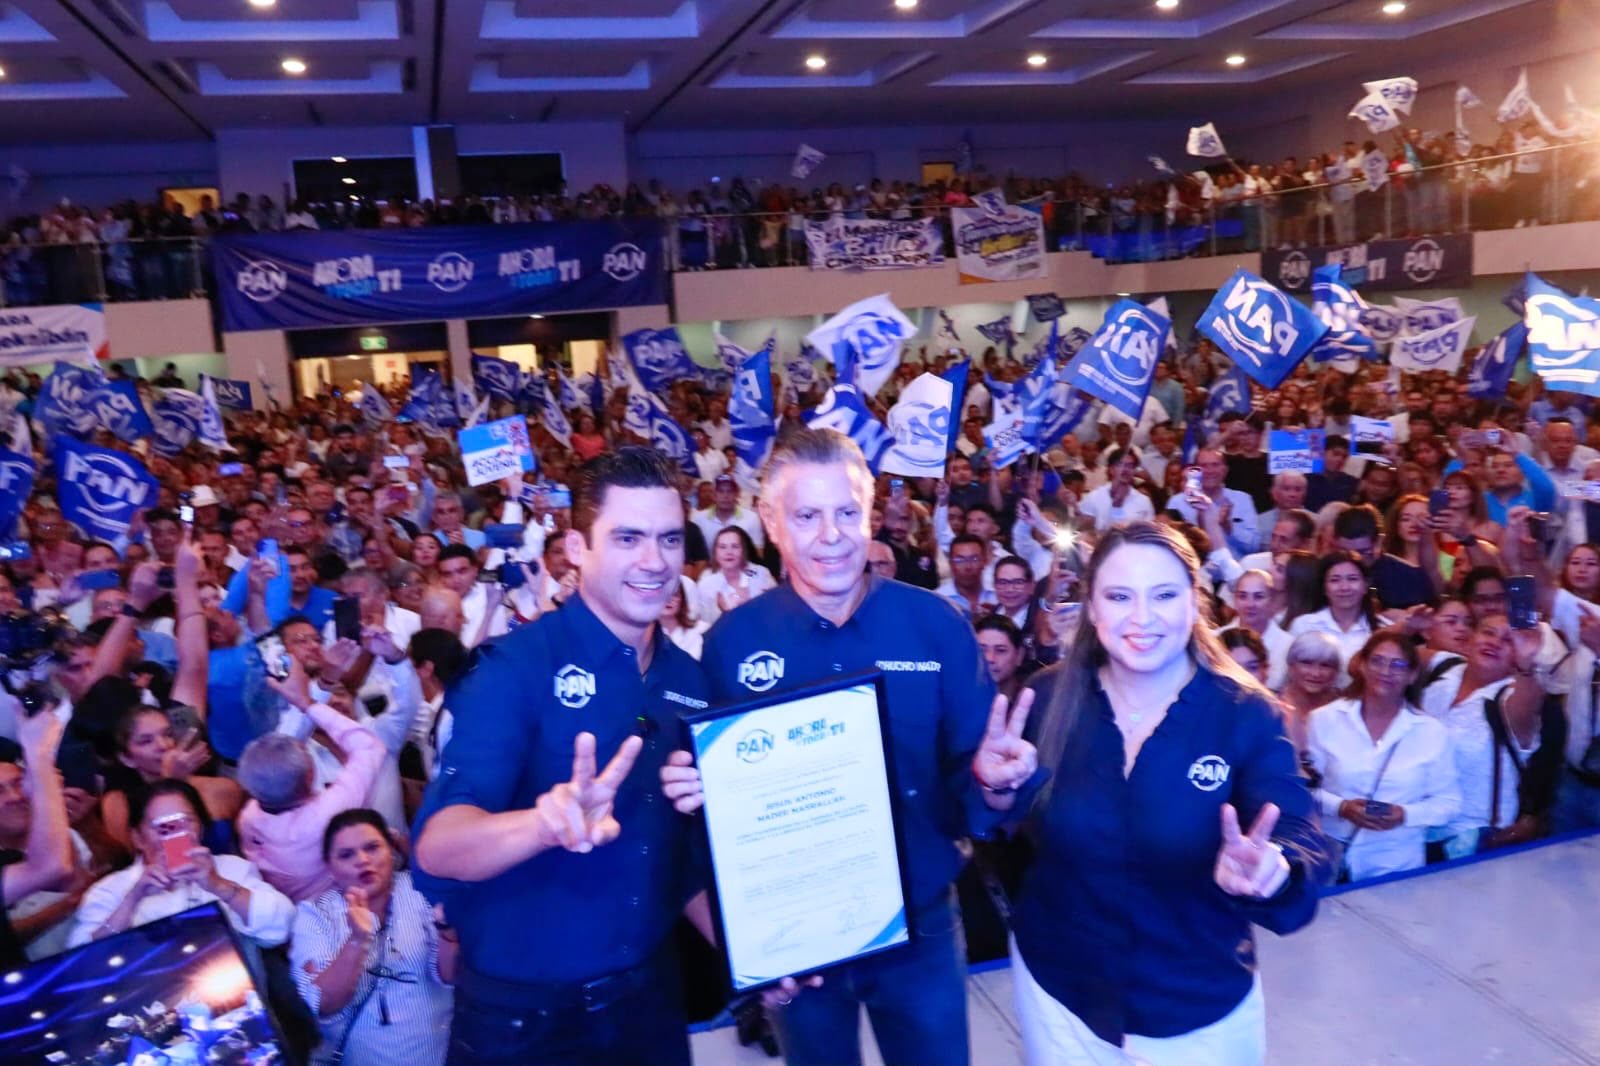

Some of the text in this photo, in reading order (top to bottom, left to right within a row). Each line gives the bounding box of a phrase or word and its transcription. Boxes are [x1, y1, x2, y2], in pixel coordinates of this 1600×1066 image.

[427, 261, 475, 282] PAN
[602, 251, 646, 272] PAN
[1403, 249, 1444, 272] PAN
[237, 270, 287, 293] PAN
[738, 657, 785, 683] PAN
[554, 672, 596, 698] PAN
[736, 734, 774, 758] PAN
[1187, 762, 1230, 782] PAN
